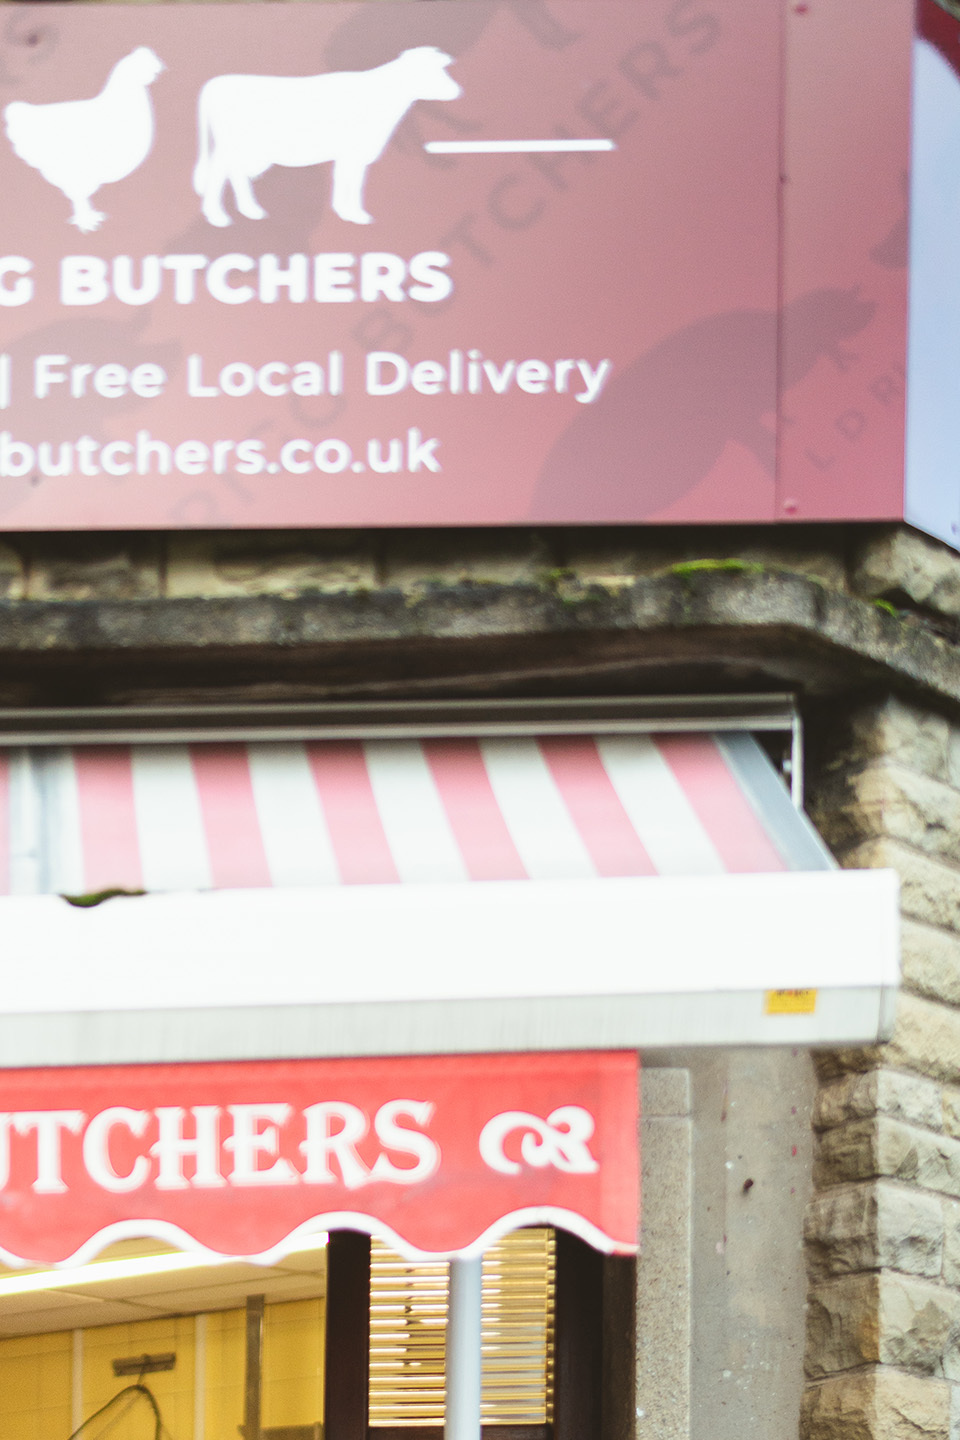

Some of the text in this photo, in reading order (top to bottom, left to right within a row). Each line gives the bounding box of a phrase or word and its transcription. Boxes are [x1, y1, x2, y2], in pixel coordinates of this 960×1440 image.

[61, 251, 451, 306] BUTCHERS
[35, 355, 165, 399] Free
[188, 352, 340, 397] Local
[366, 350, 609, 404] Delivery
